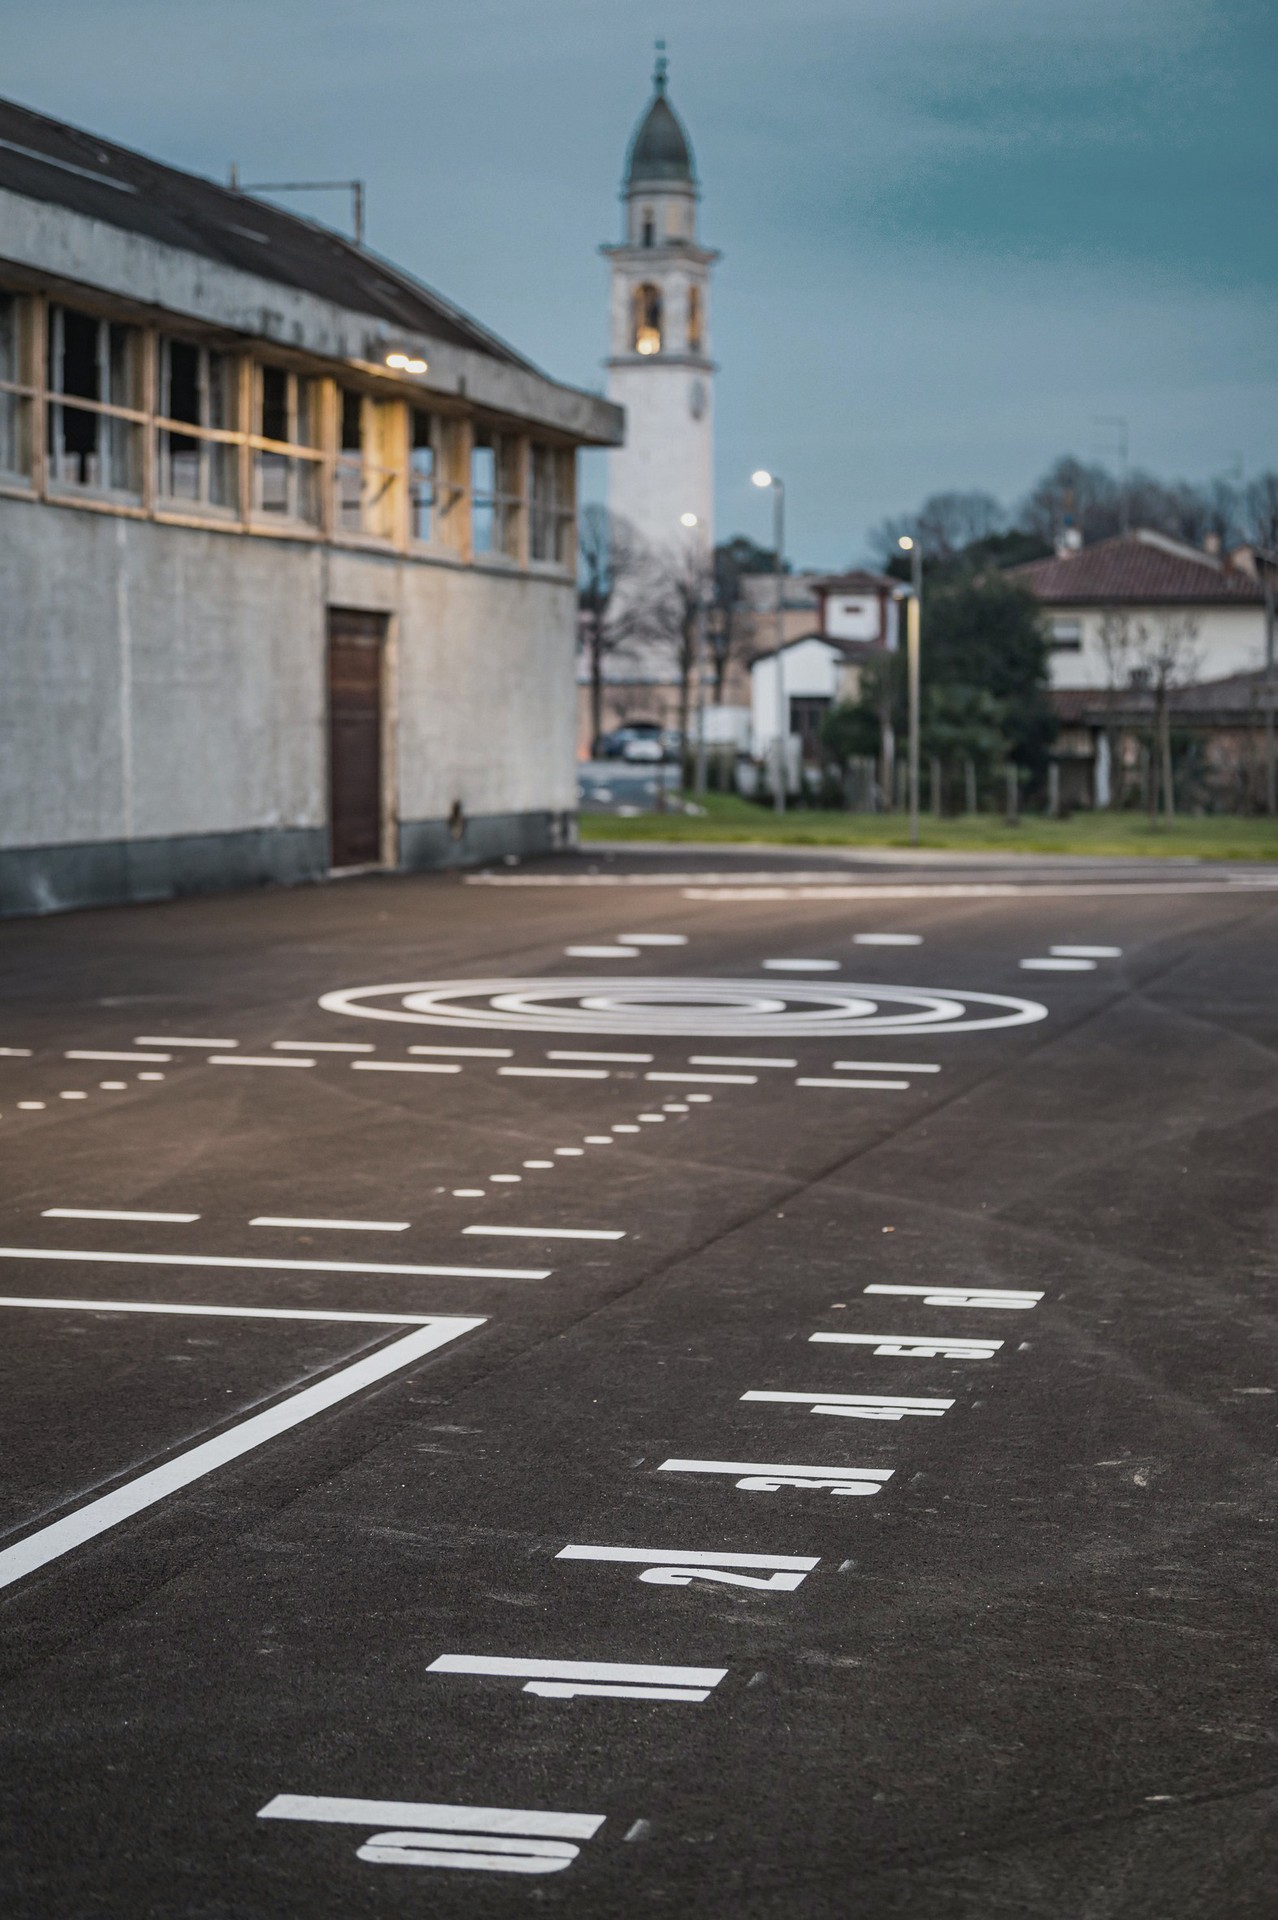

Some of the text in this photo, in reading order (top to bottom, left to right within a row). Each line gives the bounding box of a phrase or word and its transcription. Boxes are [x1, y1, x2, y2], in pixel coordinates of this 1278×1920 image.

[923, 1296, 1037, 1309] 6
[873, 1345, 995, 1359] 5
[810, 1405, 945, 1420] 4
[735, 1476, 882, 1496] 3
[638, 1566, 807, 1591] 2
[523, 1680, 710, 1702] 1
[356, 1832, 579, 1874] 0
